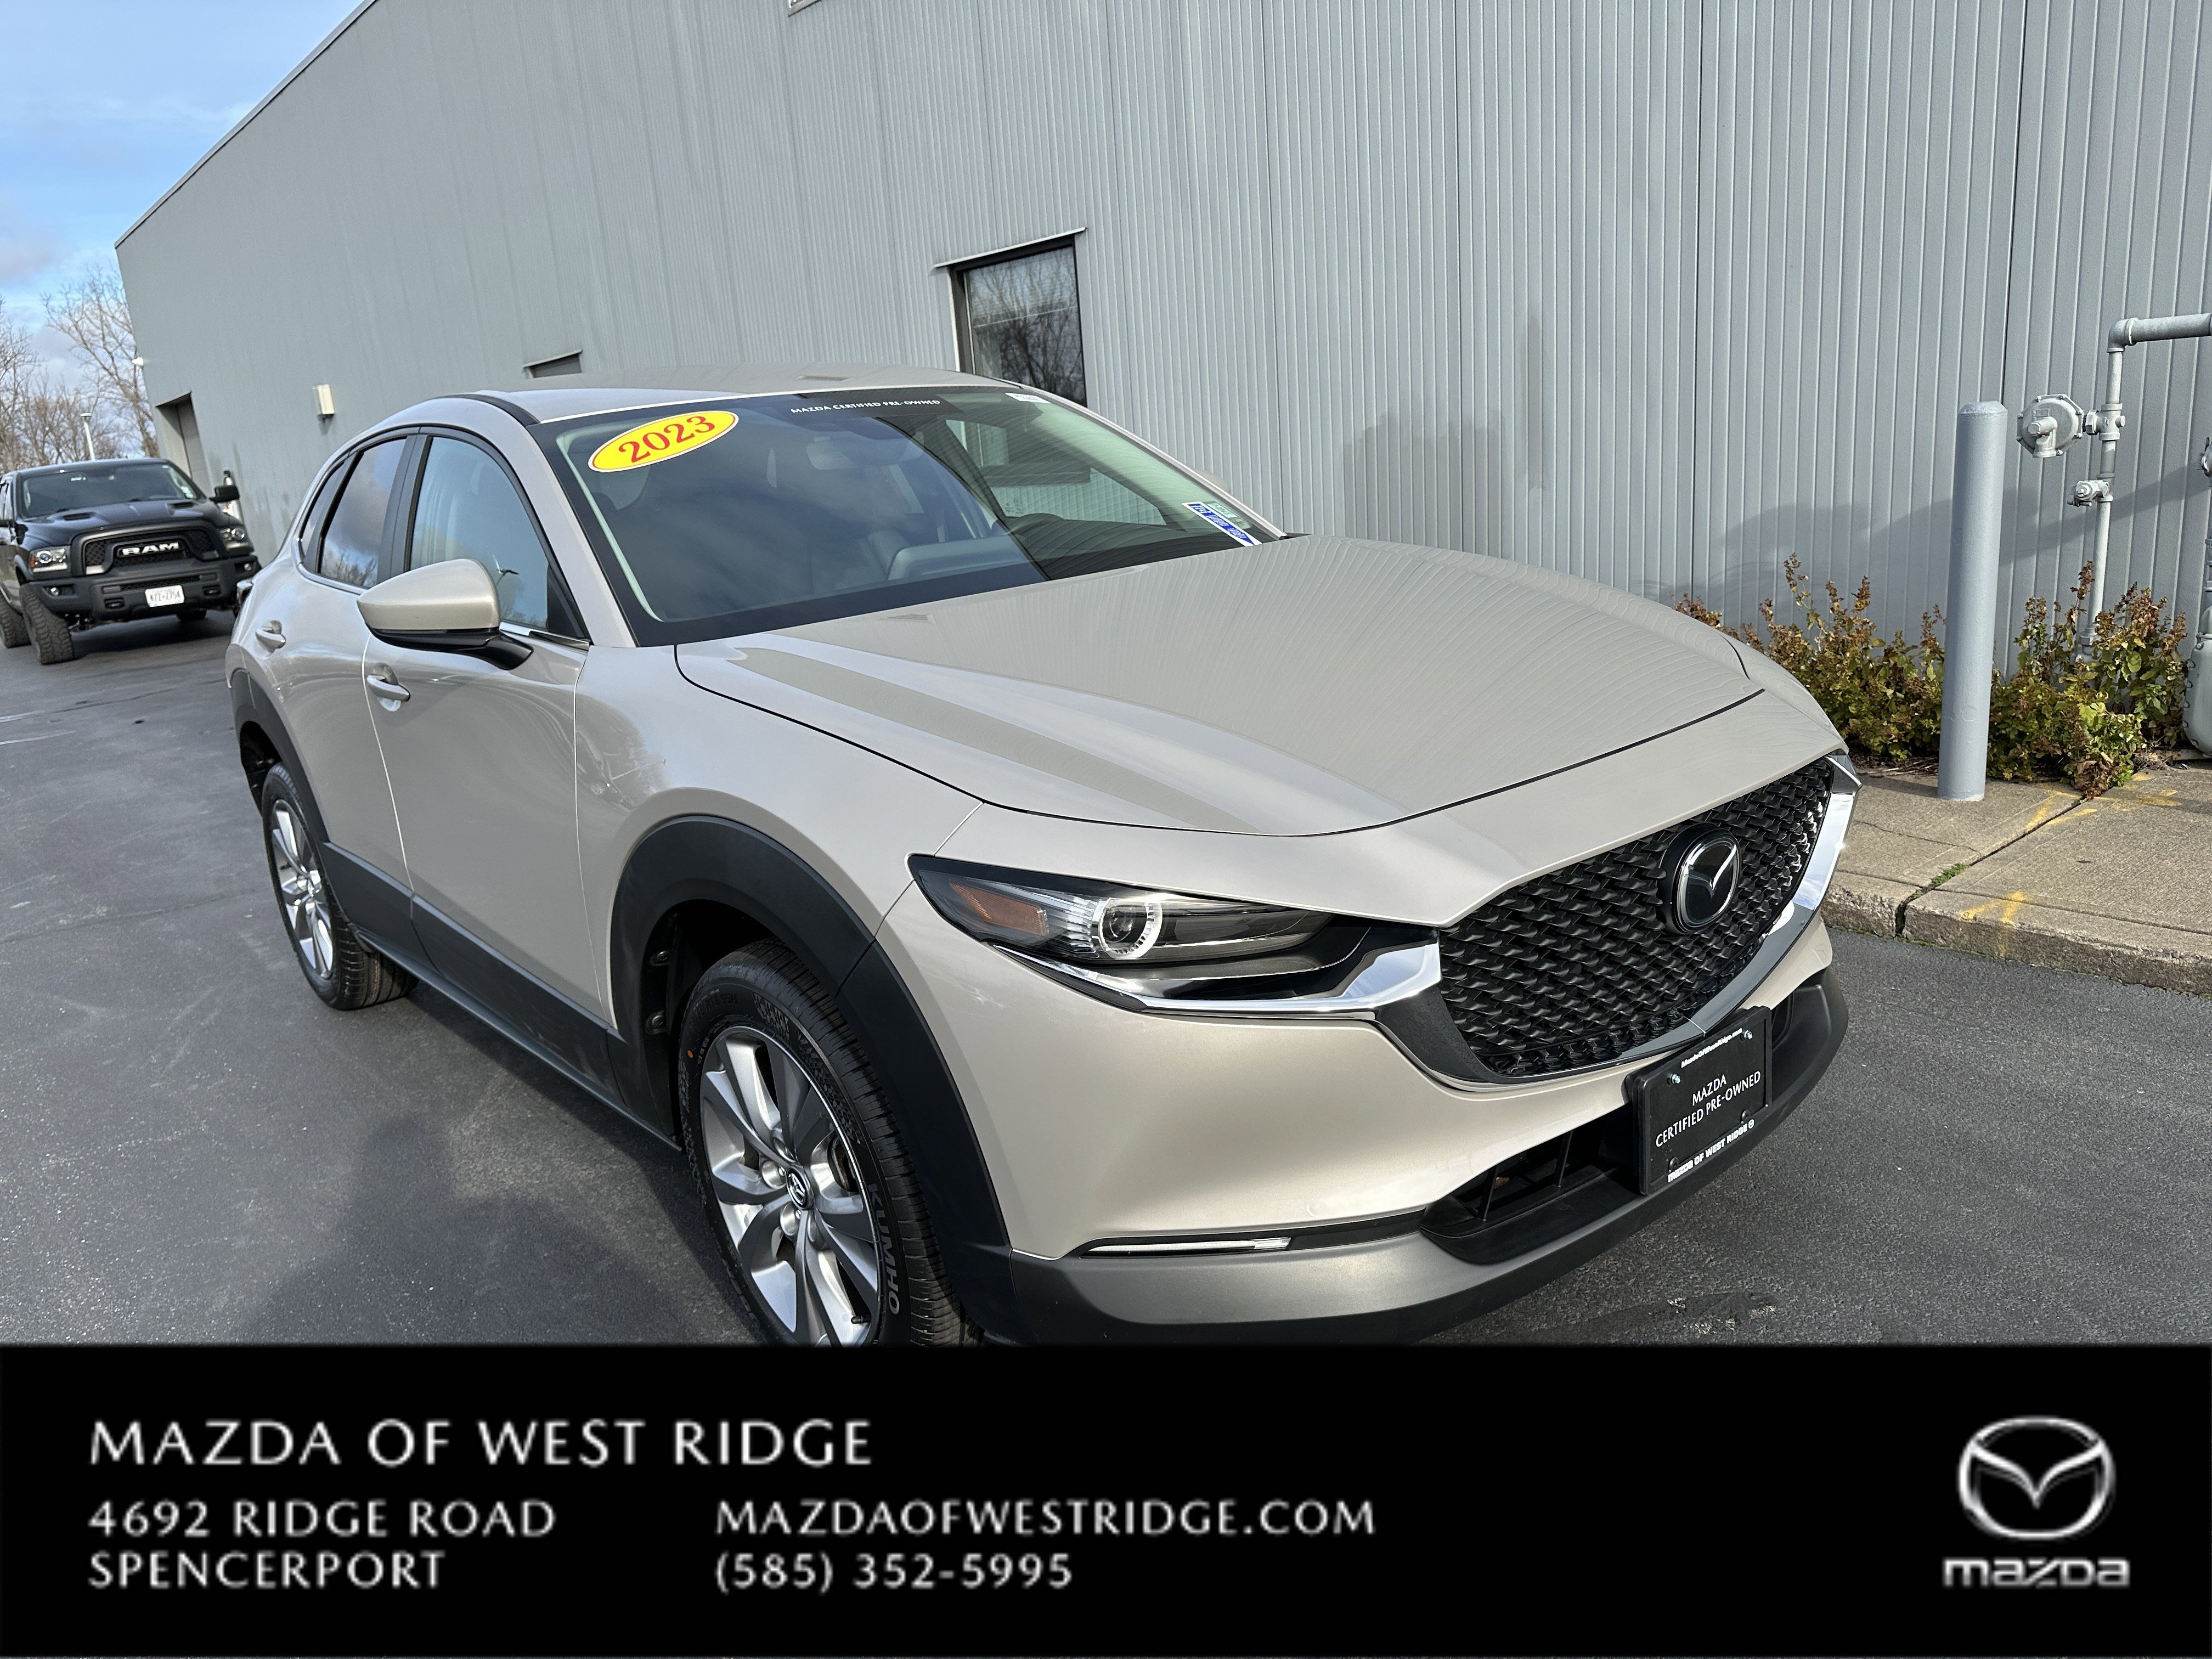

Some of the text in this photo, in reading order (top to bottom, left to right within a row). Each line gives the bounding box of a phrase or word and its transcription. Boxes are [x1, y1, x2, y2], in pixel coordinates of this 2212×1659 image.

[618, 415, 715, 463] 2023
[122, 542, 179, 556] RAM
[1656, 1071, 1761, 1147] CERTIFIED PRE-OWNED
[1692, 1074, 1727, 1107] MAZDA
[1694, 1152, 1704, 1165] OF
[1705, 1138, 1726, 1158] WEST
[1726, 1123, 1748, 1144] RIDGE
[867, 1183, 900, 1315] KUMHO
